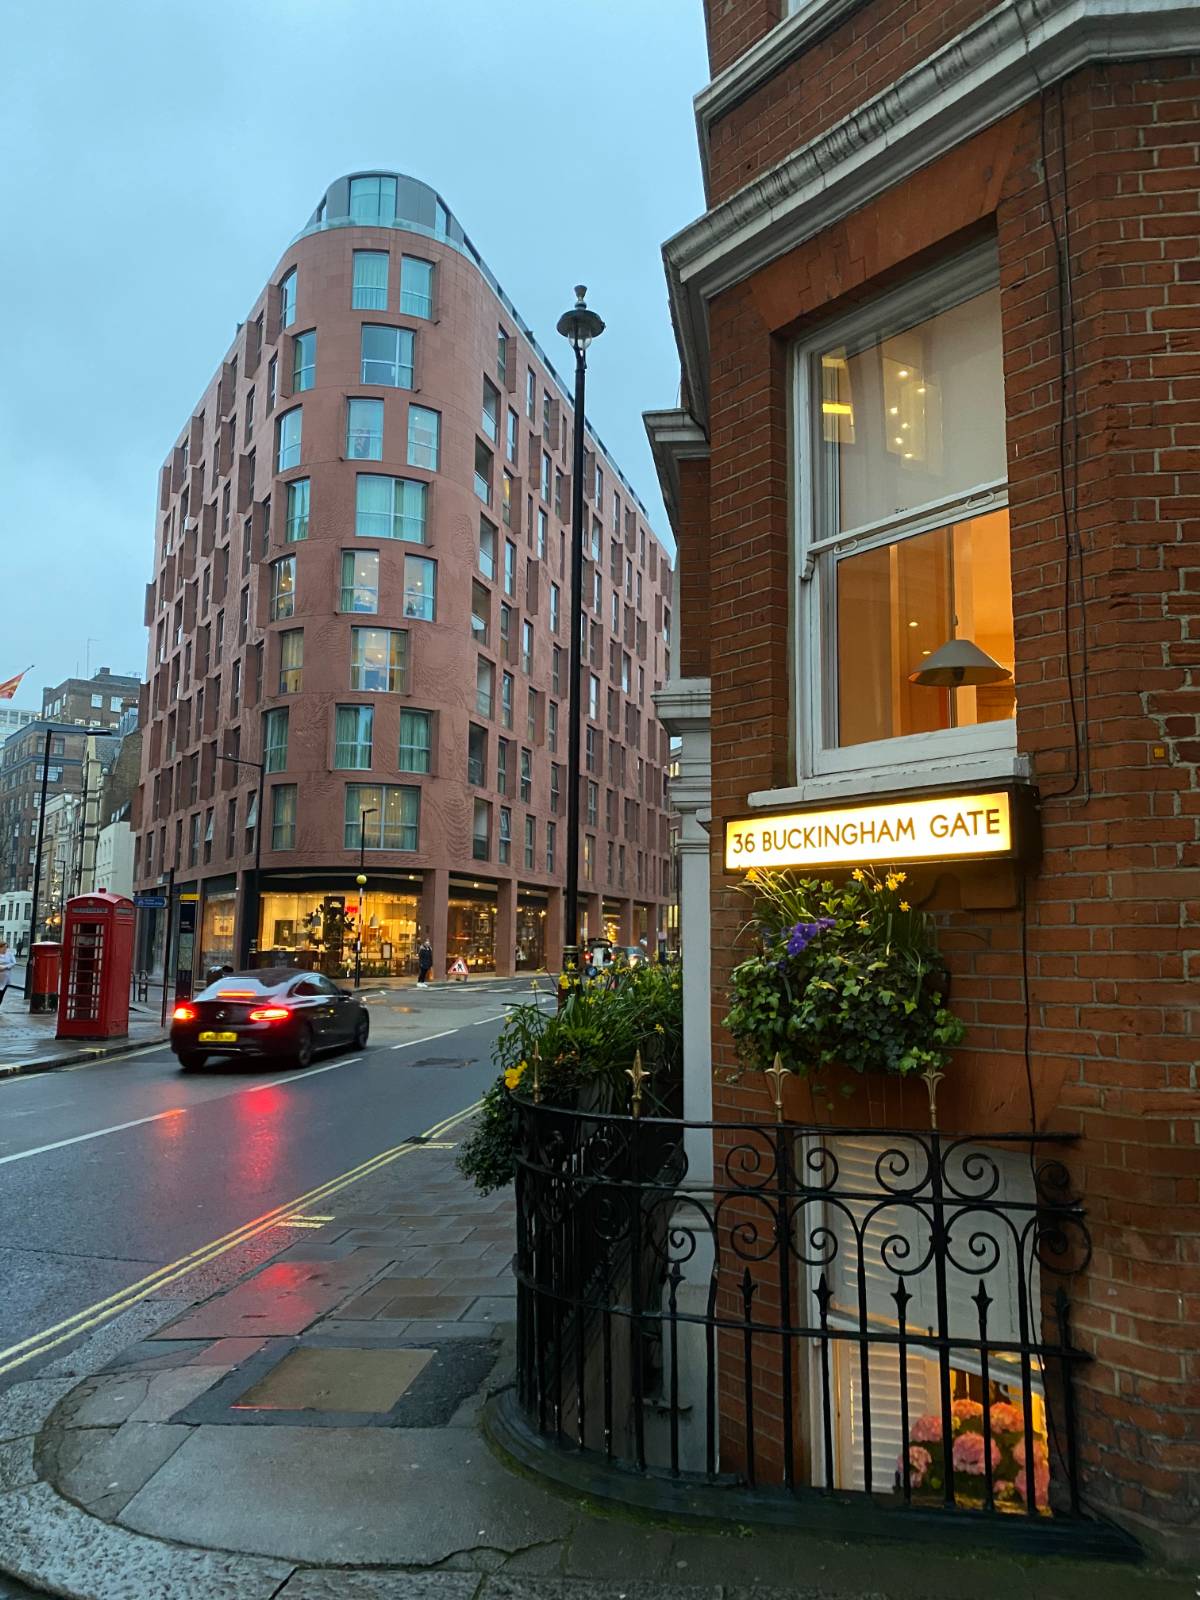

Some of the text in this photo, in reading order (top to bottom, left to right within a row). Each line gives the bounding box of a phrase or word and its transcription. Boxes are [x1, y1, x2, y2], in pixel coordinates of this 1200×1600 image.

[733, 808, 1000, 854] 36 BUCKINGHAM GATE
